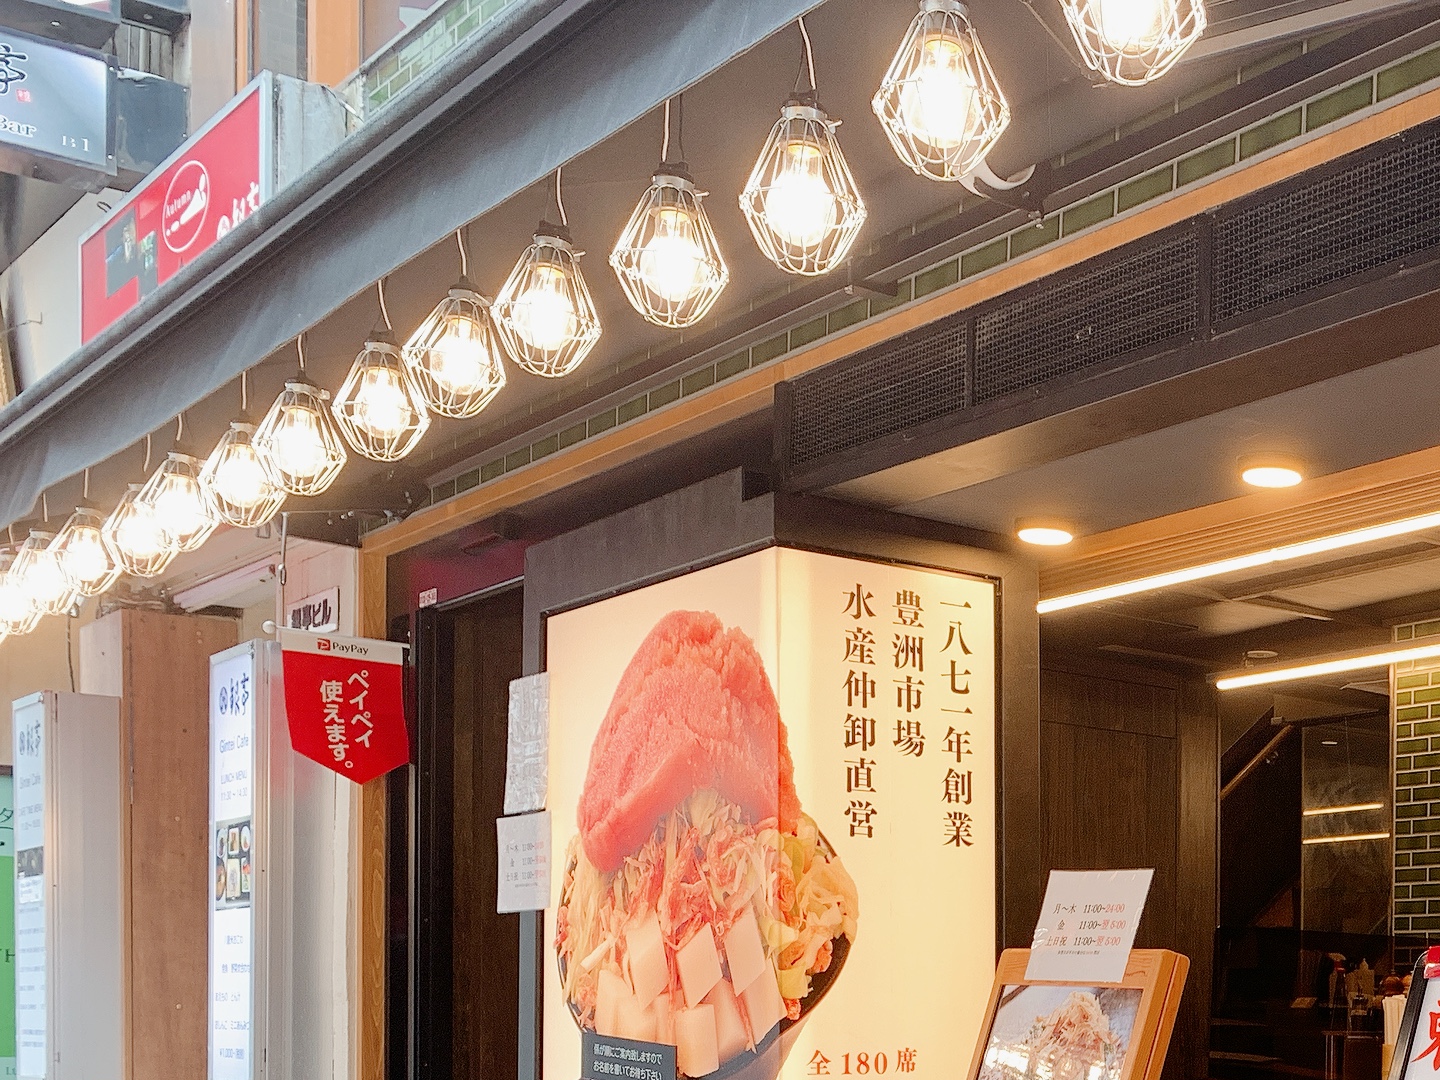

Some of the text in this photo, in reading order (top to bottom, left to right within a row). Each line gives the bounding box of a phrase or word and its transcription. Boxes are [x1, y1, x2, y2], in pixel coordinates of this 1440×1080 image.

[332, 641, 369, 656] PayPay
[891, 588, 926, 758] 豊洲市場
[319, 680, 354, 769] 使えます。
[347, 669, 374, 748] ペイペイ
[841, 582, 878, 839] 水産仲卸直営
[939, 601, 974, 848] 一八七一年創業
[1045, 936, 1067, 947] 土日祝
[1057, 919, 1066, 931] 金
